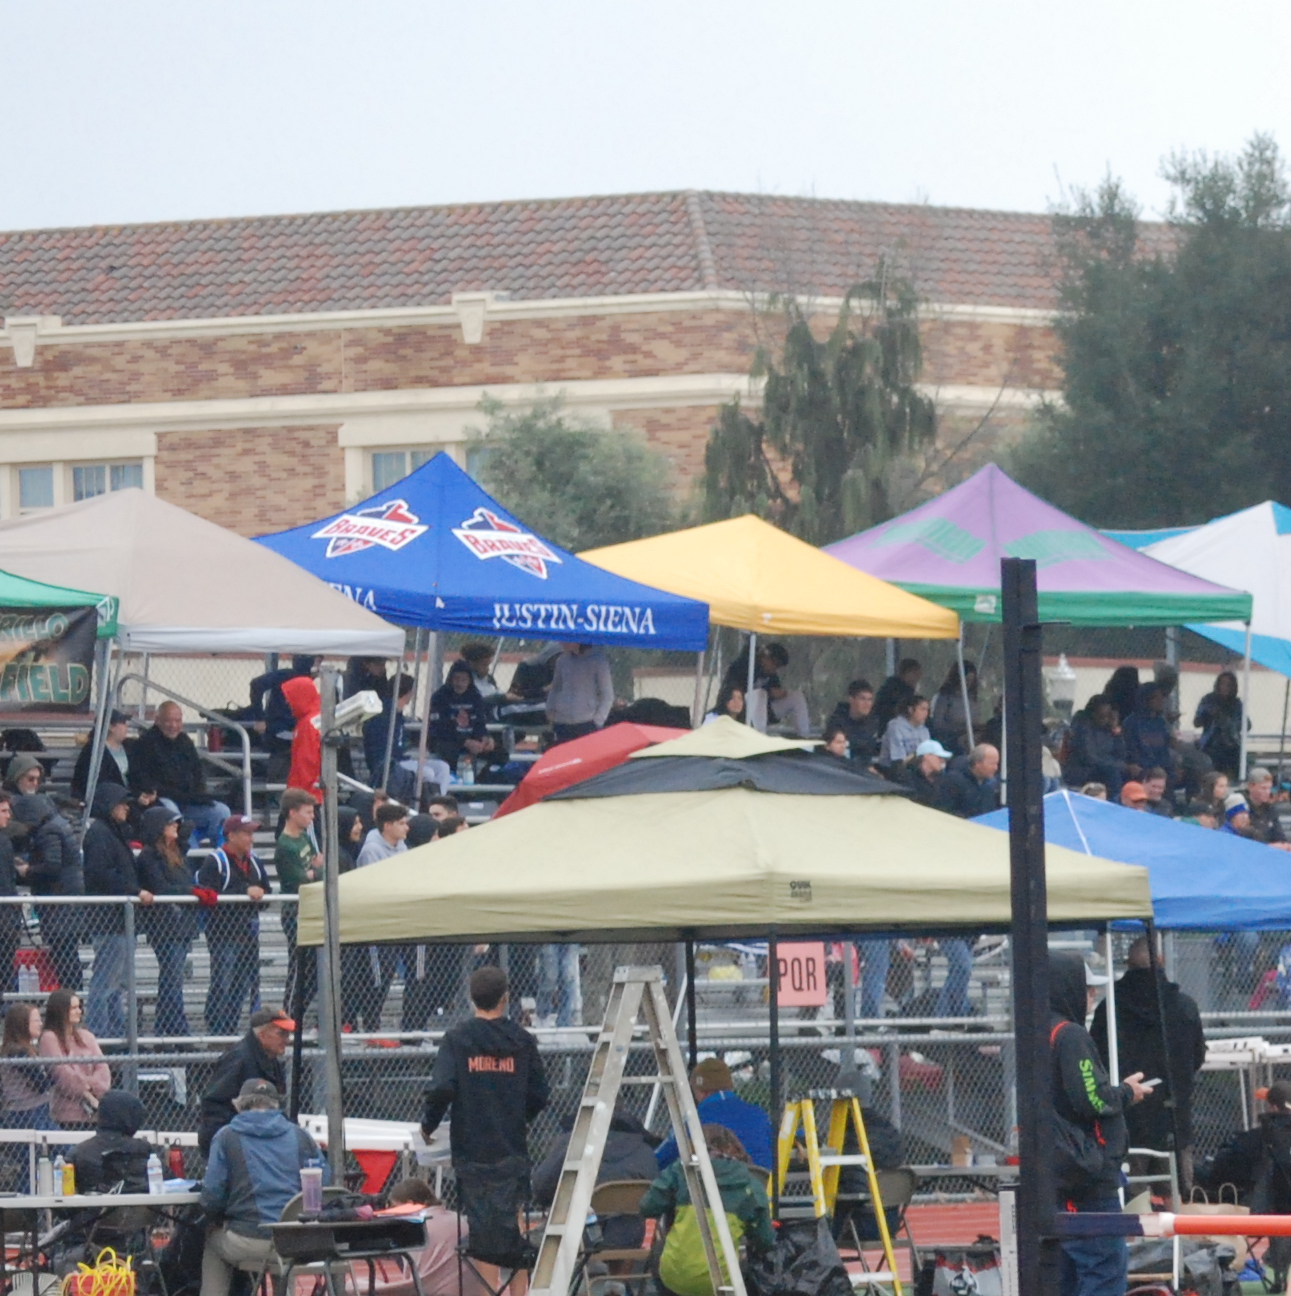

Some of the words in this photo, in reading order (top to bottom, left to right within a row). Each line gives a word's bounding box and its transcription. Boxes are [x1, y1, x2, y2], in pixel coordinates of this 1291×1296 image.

[324, 518, 419, 546] BRAVES
[461, 533, 553, 559] BRAVES
[492, 602, 657, 635] JUSTIN-SIENA
[0, 662, 91, 706] FIELD
[777, 956, 818, 993] PQR
[467, 1055, 515, 1073] MORENO
